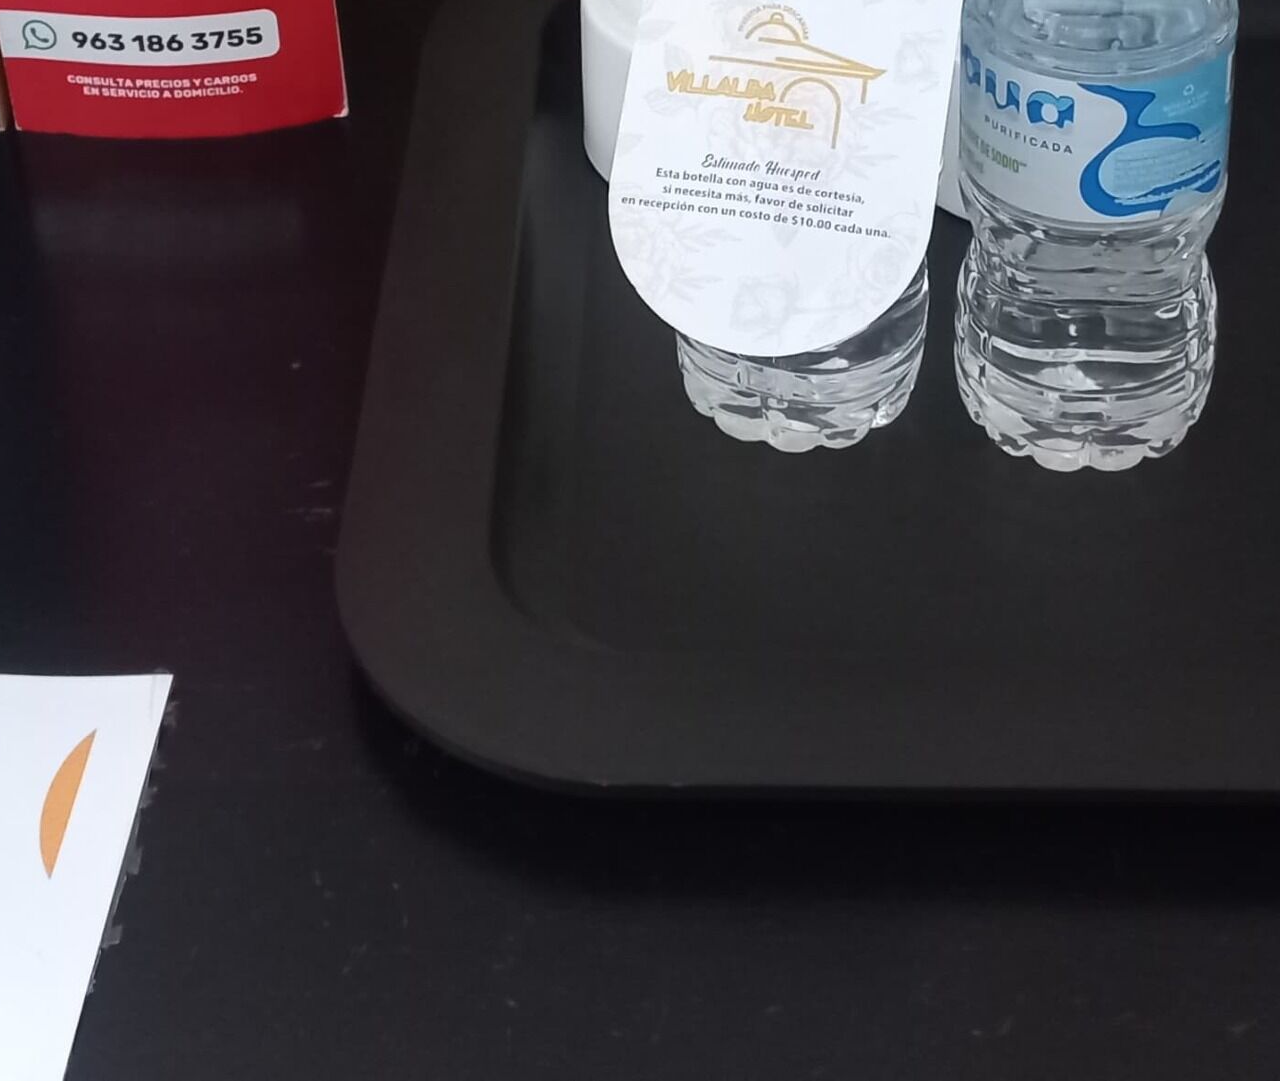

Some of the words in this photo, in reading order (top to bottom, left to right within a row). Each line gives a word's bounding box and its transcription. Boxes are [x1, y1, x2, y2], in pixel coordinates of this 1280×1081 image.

[71, 31, 126, 51] 963
[131, 34, 184, 53] 186
[191, 26, 263, 51] 3755
[67, 74, 134, 88] CONSULTA
[136, 78, 191, 89] PRECIOS
[193, 78, 202, 88] Y
[83, 86, 101, 96] EN
[101, 87, 161, 99] SERVICIO
[162, 89, 172, 99] A
[666, 68, 776, 102] VILLALBA
[742, 100, 814, 130] HOTEL
[984, 114, 1073, 155] PURIFICADA
[700, 153, 761, 172] Estimado
[655, 167, 681, 180] Esta
[682, 169, 724, 185] botella
[726, 177, 747, 187] con
[749, 179, 779, 192] agua
[781, 183, 795, 193] es
[796, 182, 813, 196] de
[662, 183, 673, 194] si
[674, 185, 723, 199] necesita
[724, 189, 753, 204] más,
[754, 193, 786, 208] favor
[788, 196, 804, 211] de
[805, 200, 855, 219] solicitar
[621, 195, 636, 206] en
[638, 197, 695, 213] recepción
[697, 203, 718, 215] con
[720, 206, 737, 217] un
[739, 210, 771, 222] costo
[773, 210, 789, 225] de
[791, 214, 832, 231] $10.00
[834, 220, 863, 236] cada
[865, 226, 892, 240] una.
